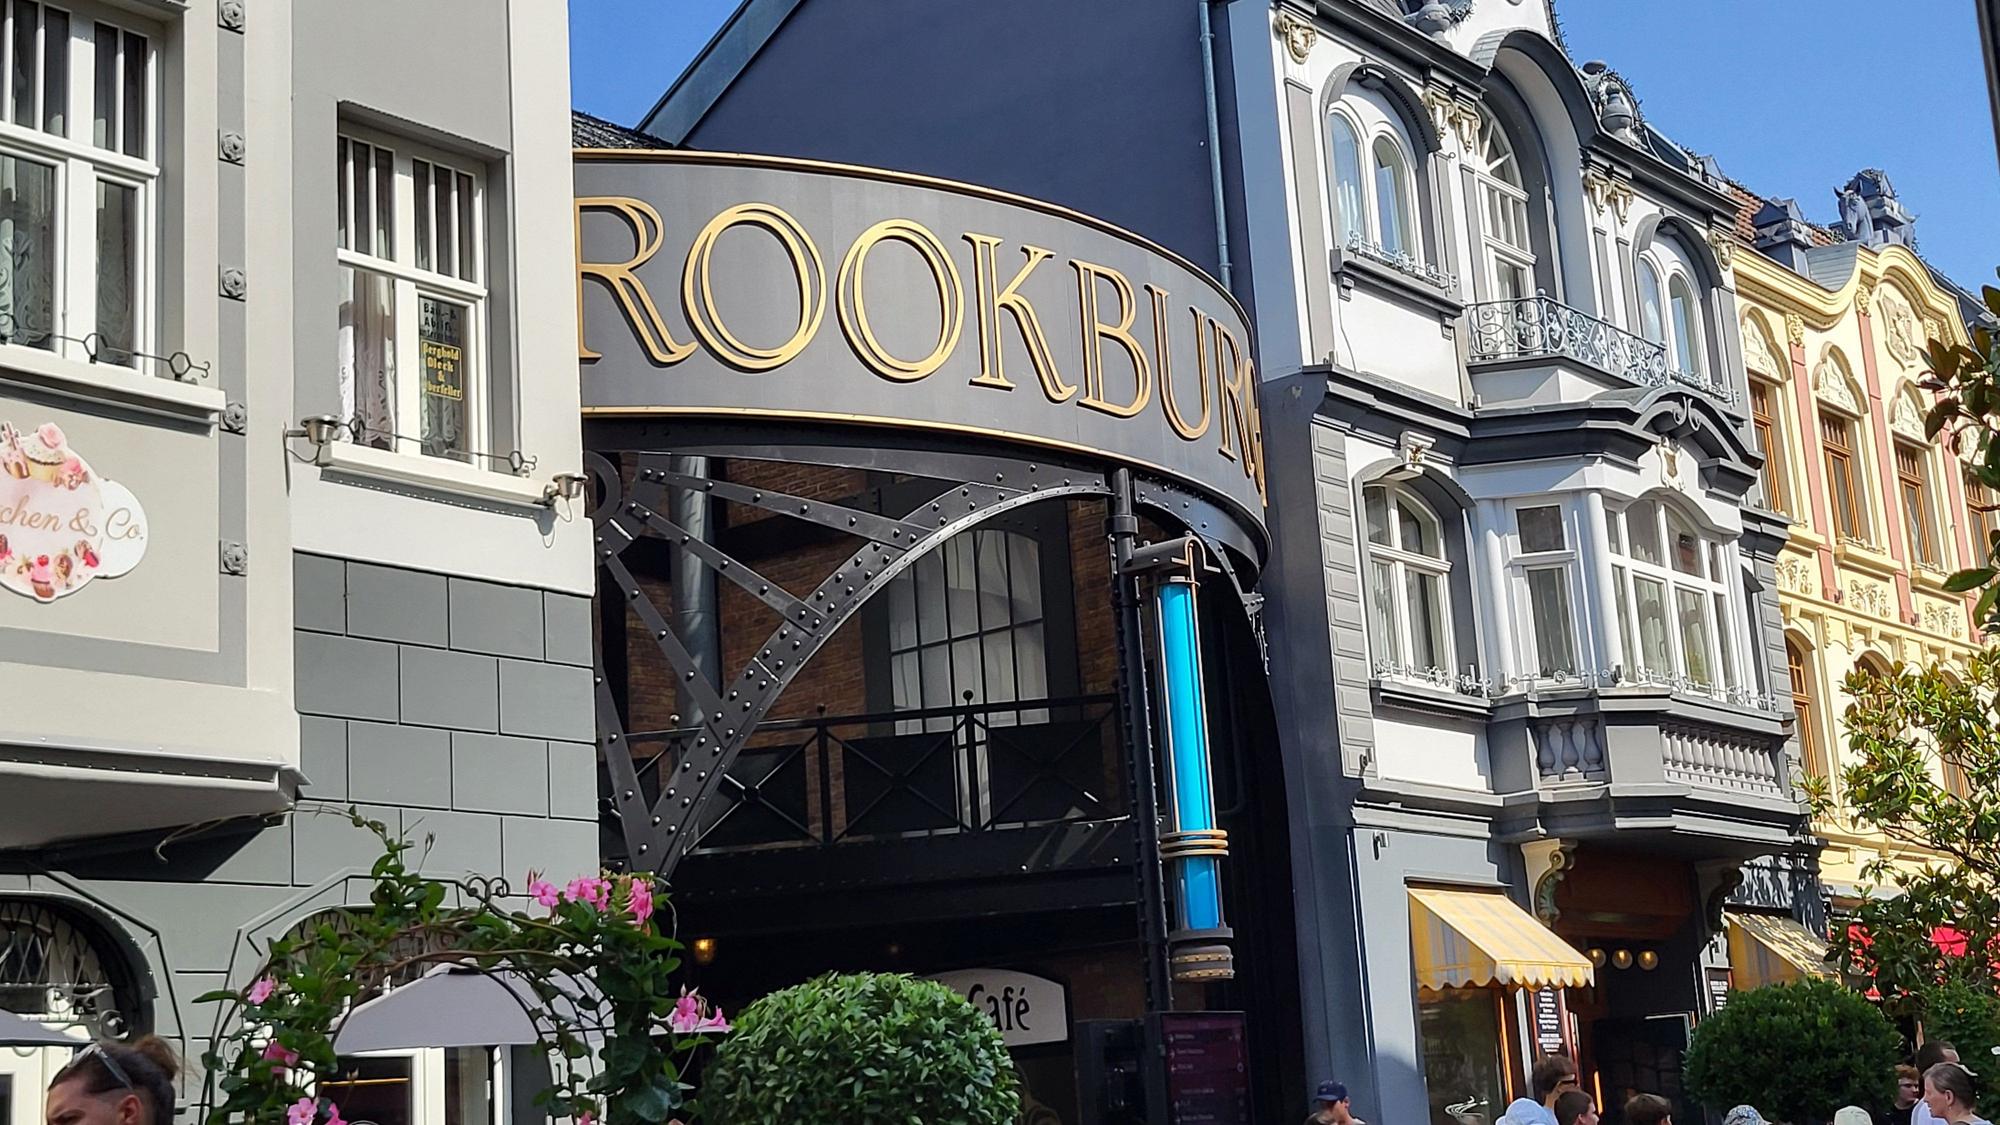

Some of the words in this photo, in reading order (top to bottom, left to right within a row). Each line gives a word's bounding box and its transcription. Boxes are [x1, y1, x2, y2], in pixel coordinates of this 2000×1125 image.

[437, 370, 446, 382] &
[69, 507, 98, 537] &
[105, 507, 144, 540] Co.
[967, 983, 1031, 1032] Café
